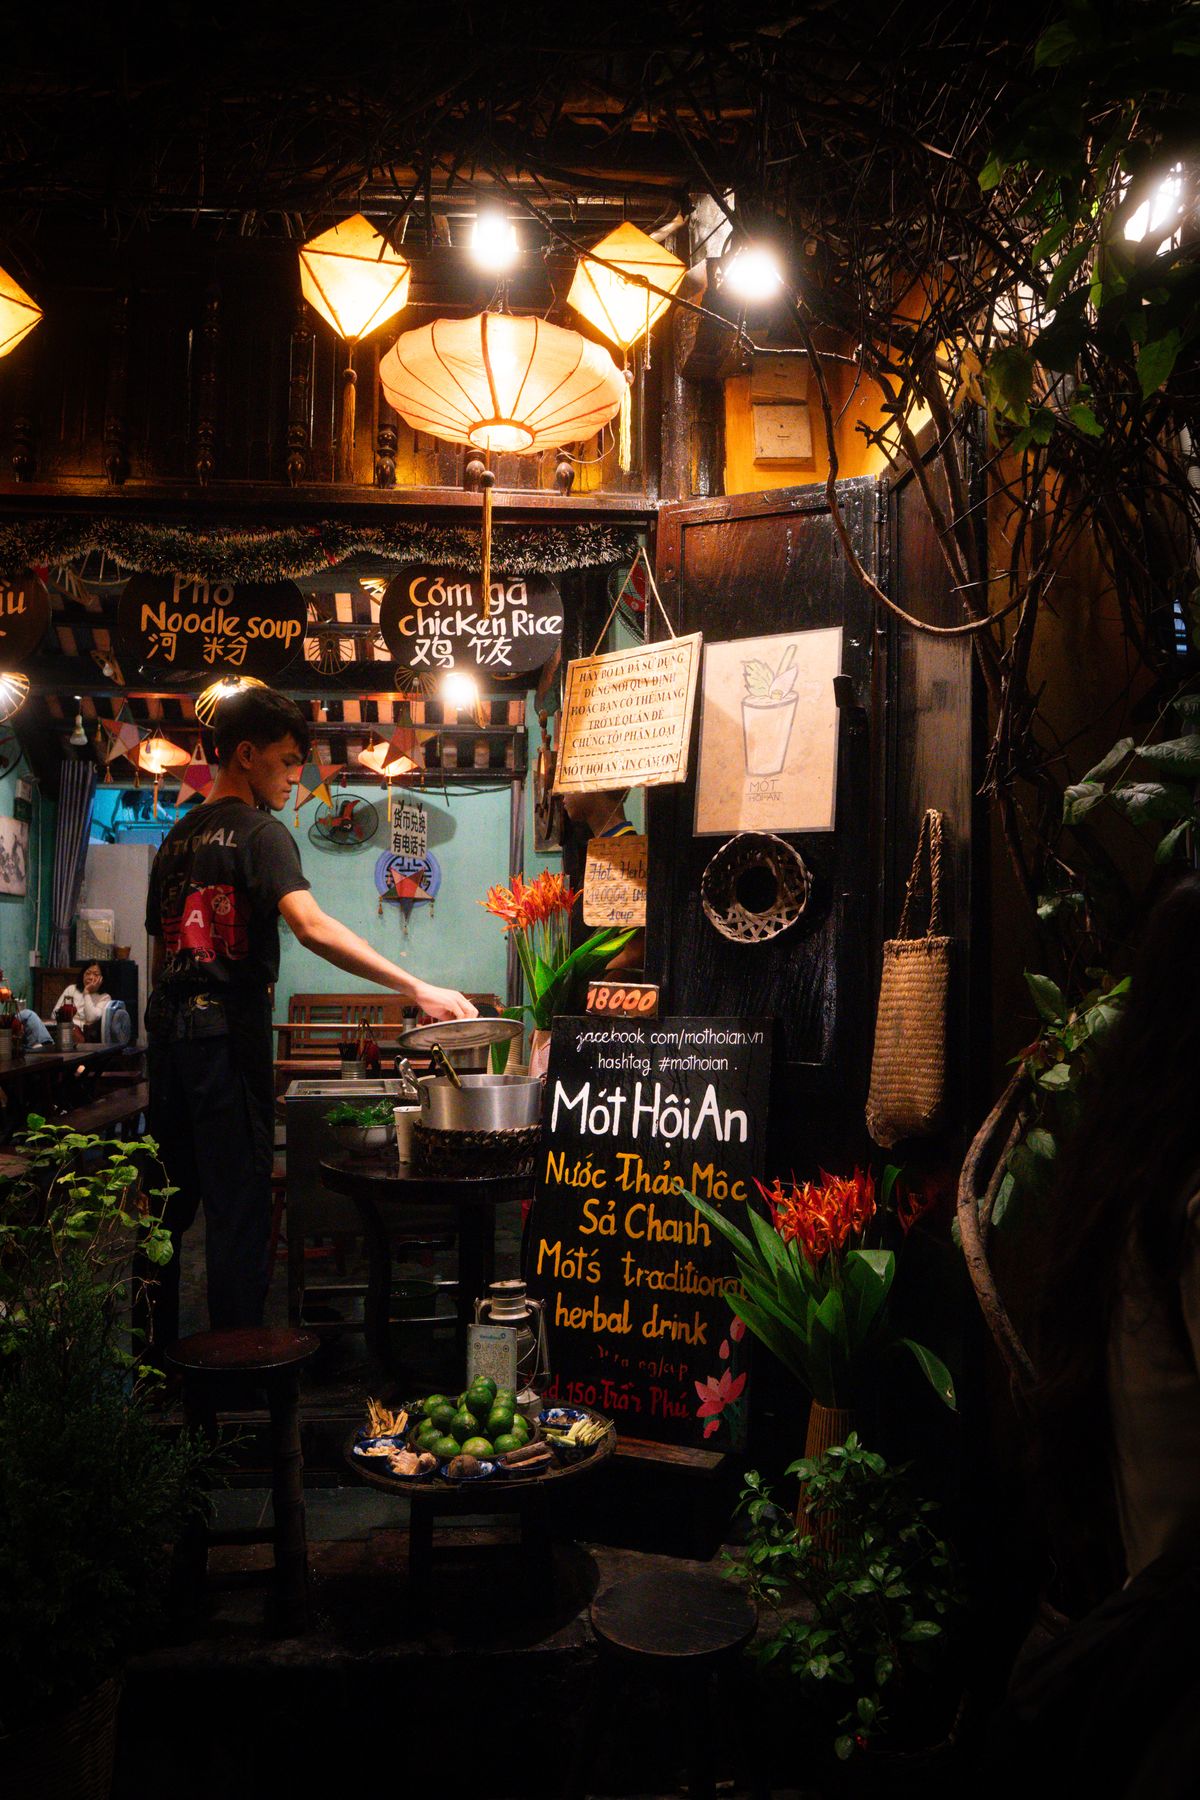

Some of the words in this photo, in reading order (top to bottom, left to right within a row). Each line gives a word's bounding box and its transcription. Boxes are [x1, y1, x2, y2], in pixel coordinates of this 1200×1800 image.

[140, 601, 241, 637] Noodle
[246, 616, 301, 649] soup
[512, 610, 563, 637] Rice
[393, 831, 426, 857] 有电话卡
[586, 988, 656, 1011] 18000
[599, 1052, 651, 1077] hashtag
[658, 1055, 728, 1072] #mothoian
[551, 1080, 627, 1136] Mót
[632, 1082, 691, 1148] Hội
[692, 1083, 747, 1142] An
[578, 1198, 617, 1236] Sả
[624, 1202, 711, 1247] Chanh
[555, 1292, 632, 1334] herbal
[642, 1303, 708, 1345] drink
